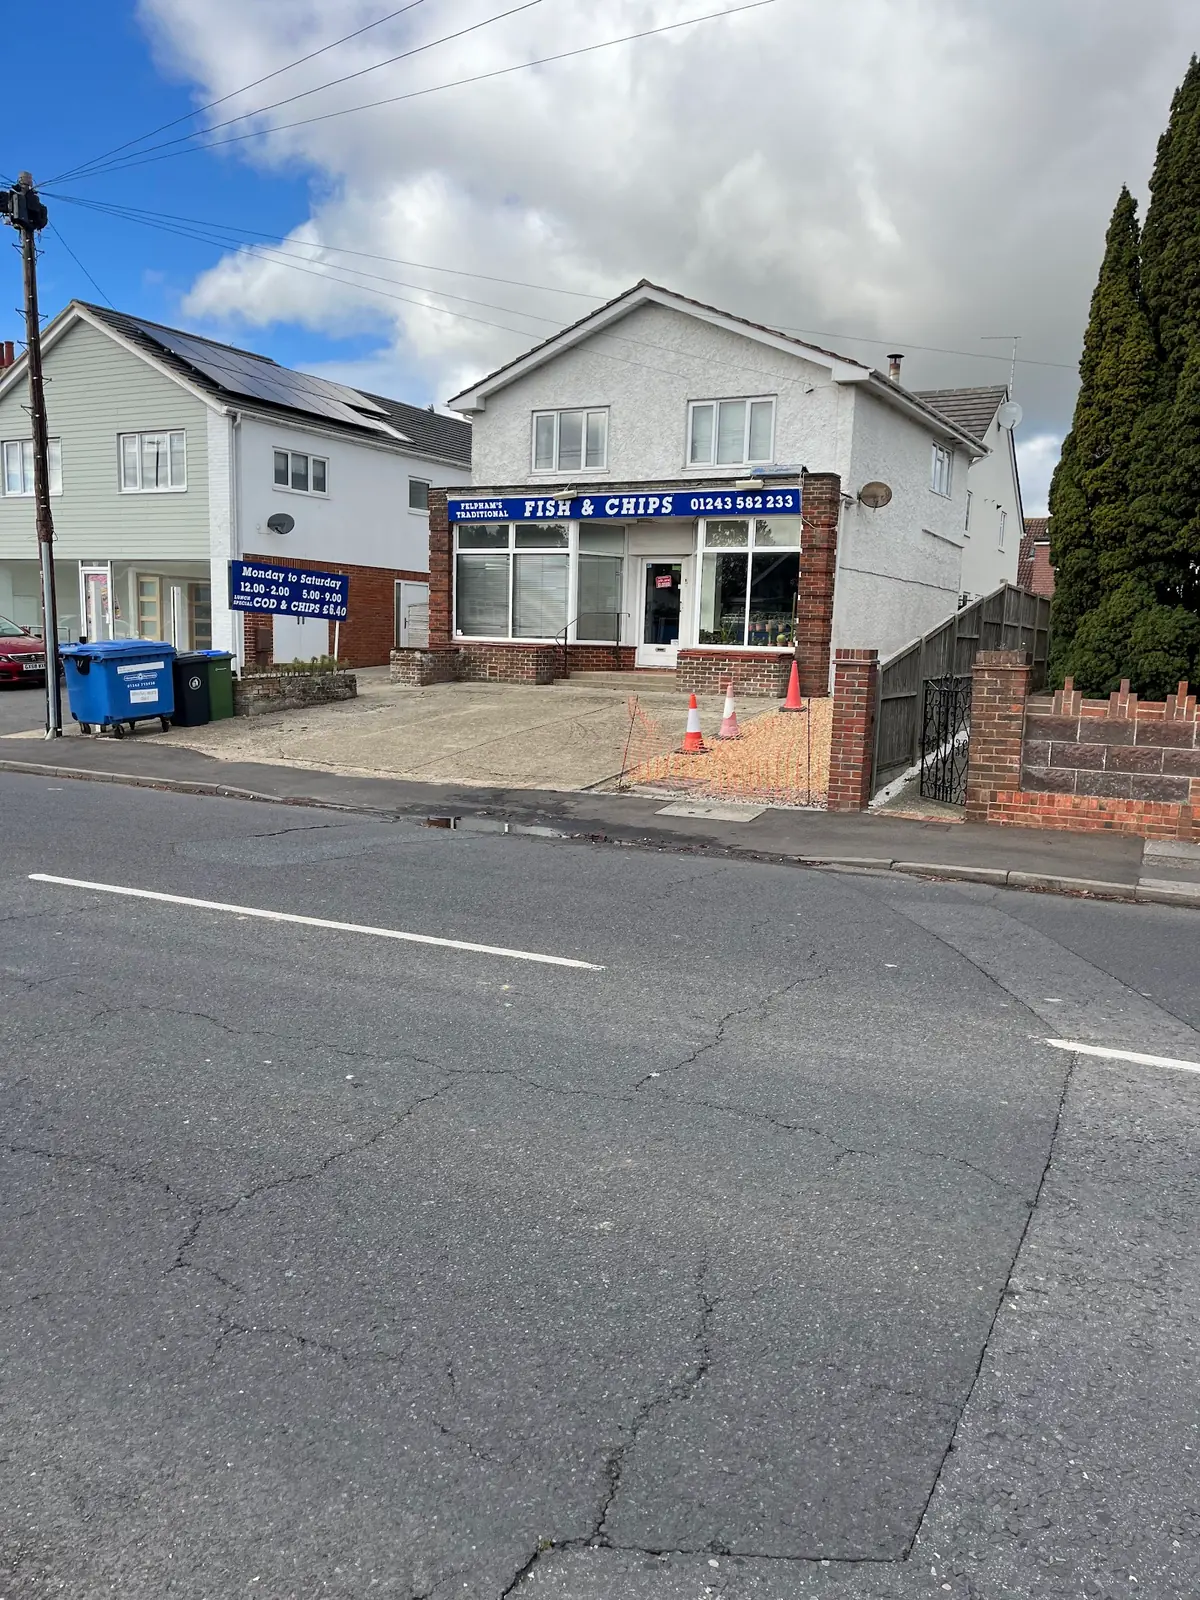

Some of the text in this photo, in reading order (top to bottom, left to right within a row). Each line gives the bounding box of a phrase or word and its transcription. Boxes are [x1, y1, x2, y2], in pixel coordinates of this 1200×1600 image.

[461, 502, 503, 510] FELPHAM'S
[524, 496, 674, 517] FISH & CHIPS
[690, 495, 794, 510] 01243 582 233
[456, 510, 508, 518] TRADITIONAL
[242, 566, 342, 590] Monday to Saturday
[254, 597, 347, 617] COD & CHIPS £6.40
